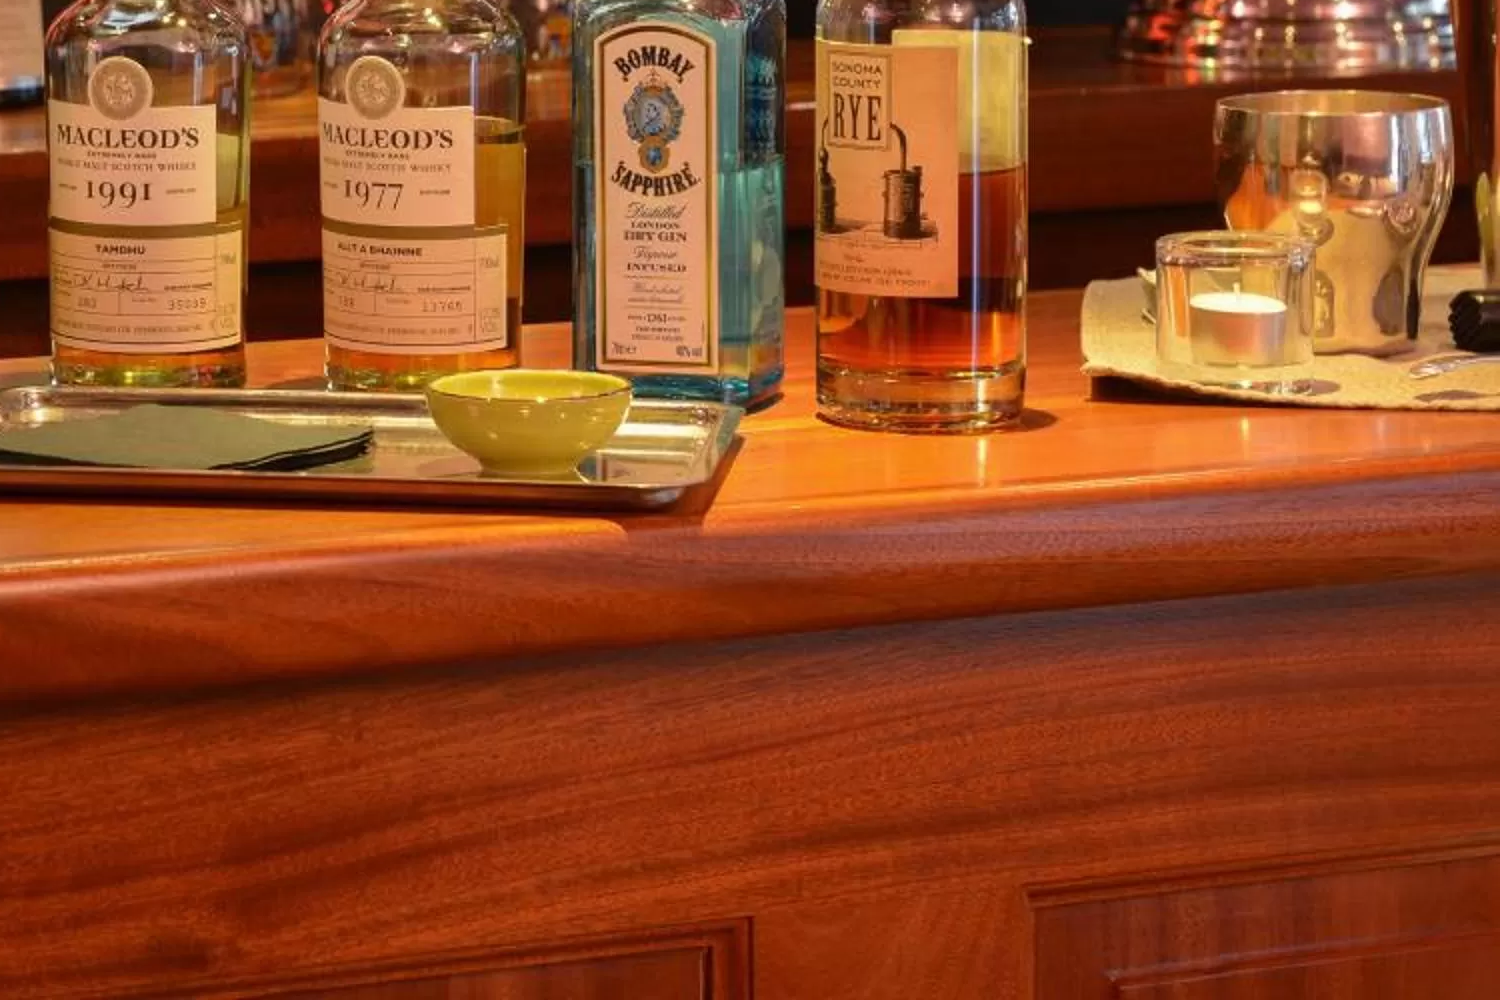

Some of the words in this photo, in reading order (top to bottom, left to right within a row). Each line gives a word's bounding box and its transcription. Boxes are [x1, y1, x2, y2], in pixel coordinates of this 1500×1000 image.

[613, 45, 696, 78] BOMBAY
[832, 61, 882, 76] SONOMA
[832, 76, 881, 89] COUNTY
[833, 92, 881, 142] RYE
[57, 124, 199, 150] MACLEOD'S
[323, 122, 454, 150] MACLEOD'S
[611, 164, 698, 197] SAPPHIRE
[85, 180, 153, 209] 1991
[343, 179, 404, 210] 1977
[96, 243, 146, 255] TAMDHU
[623, 231, 657, 241] DRY
[657, 231, 687, 242] GIN
[627, 263, 687, 273] INFUSED
